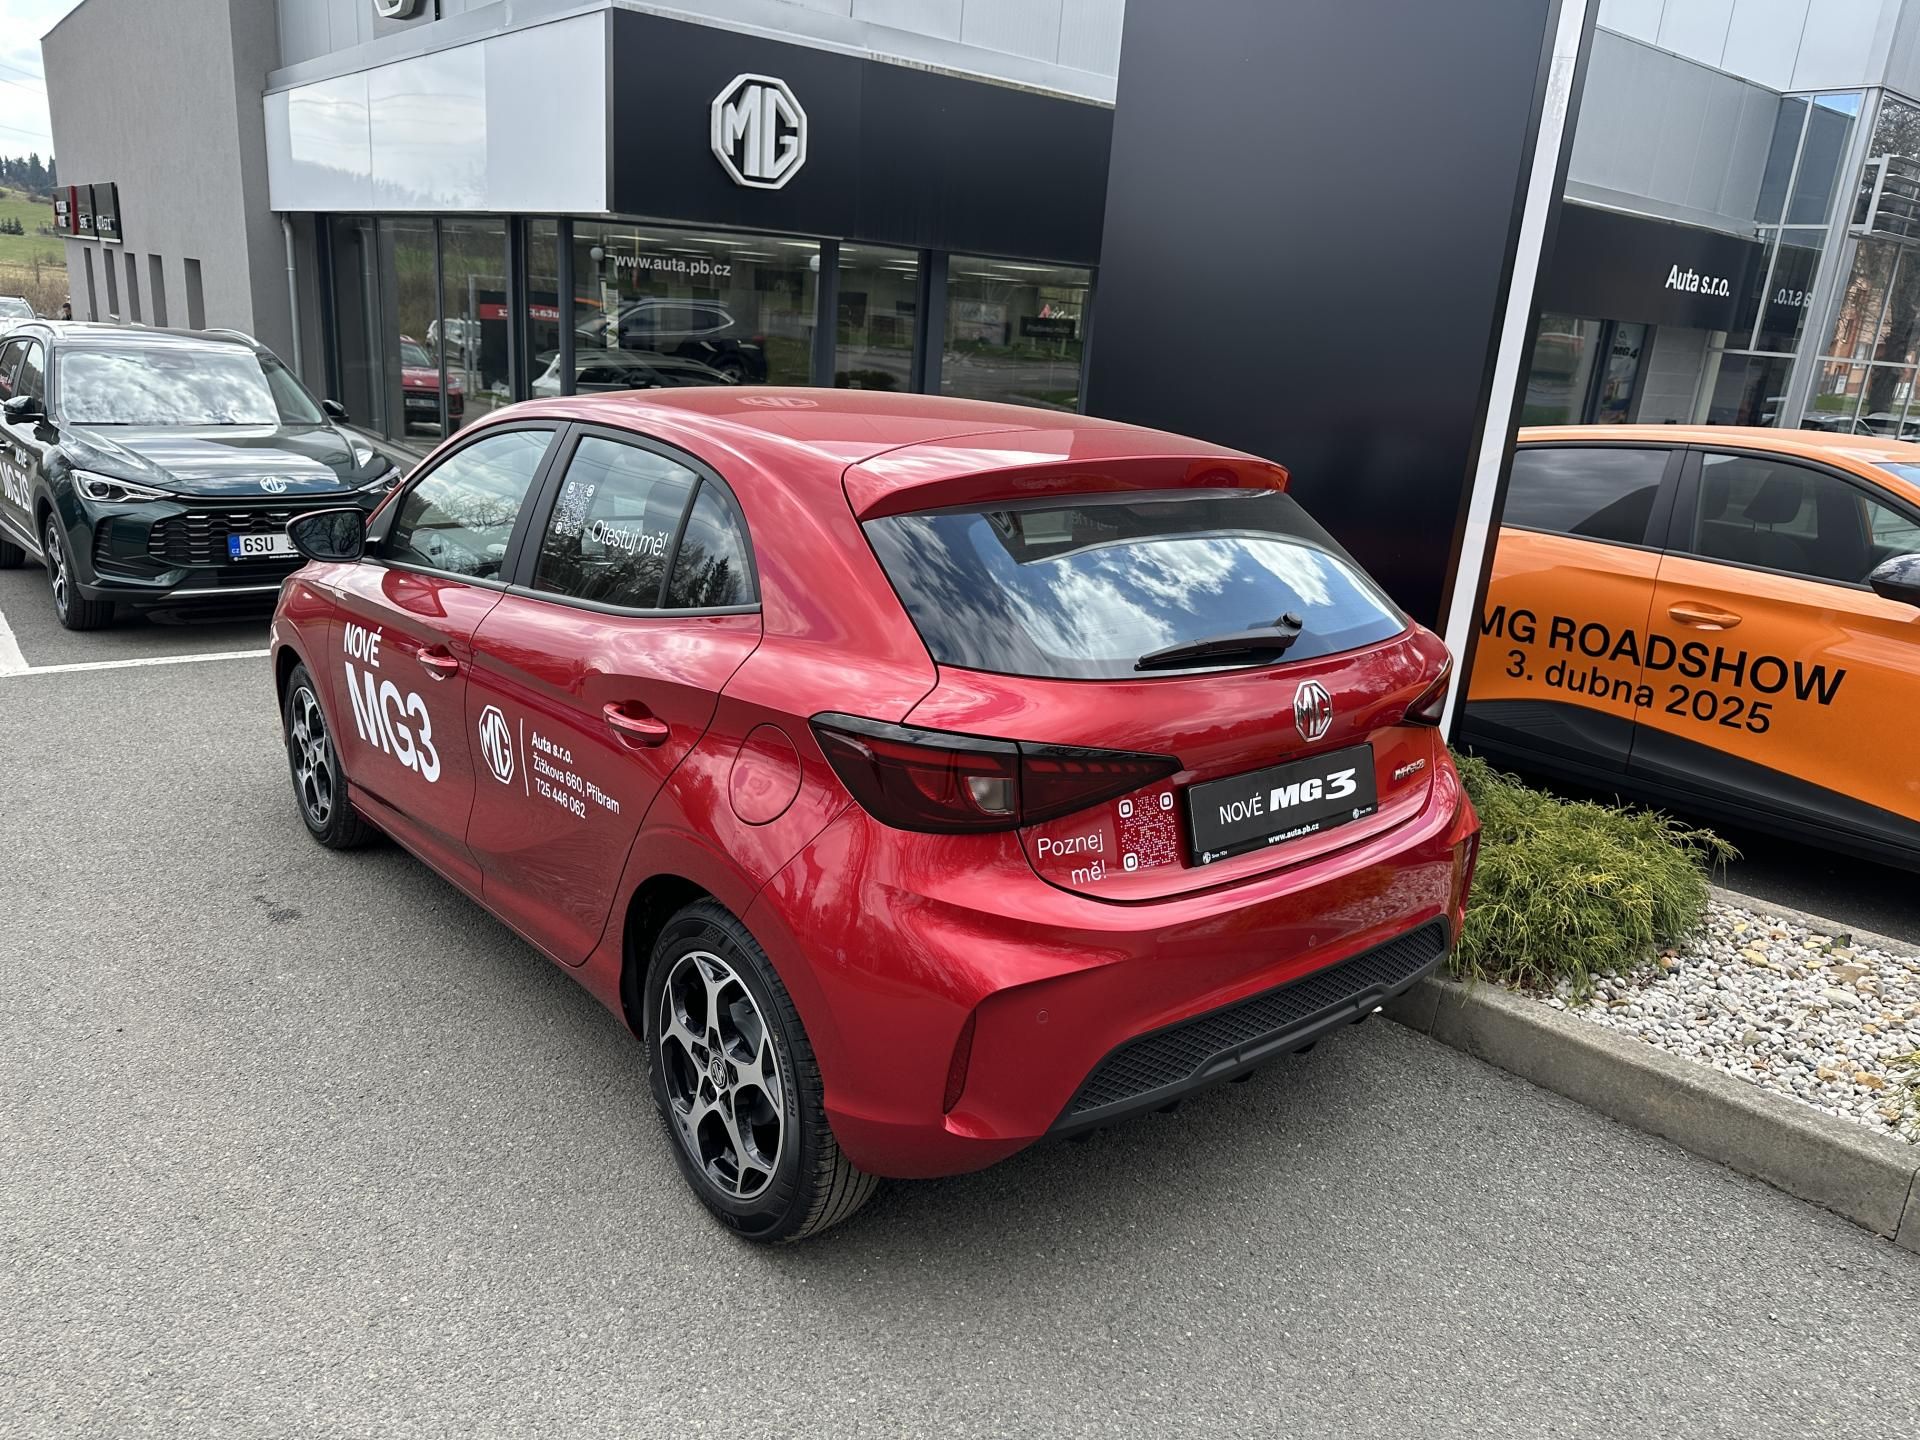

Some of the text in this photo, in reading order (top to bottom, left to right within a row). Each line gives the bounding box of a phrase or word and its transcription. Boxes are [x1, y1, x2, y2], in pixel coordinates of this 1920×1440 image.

[721, 84, 800, 179] MG
[614, 254, 732, 276] www.auta.pb.cz
[1665, 264, 1730, 297] Auta s.r.o.
[262, 477, 285, 492] MG
[244, 537, 274, 553] 6SU
[592, 519, 669, 557] Otestuj mě!
[344, 622, 382, 668] NOVÉ
[1480, 605, 1847, 706] MG ROADSHOW
[1296, 684, 1332, 737] MG
[1506, 650, 1773, 734] 3. dubna 2025
[345, 661, 441, 783] MG3
[481, 712, 512, 777] MG
[531, 731, 574, 765] Auta s.r.o.
[532, 751, 620, 815] Žižkova 660, Příbram
[535, 777, 586, 820] 725 446 062
[1219, 792, 1263, 825] NOVÉ
[1037, 828, 1104, 859] Poznej
[1268, 822, 1320, 844] www.auta.pb.cz
[1071, 859, 1107, 885] mě!
